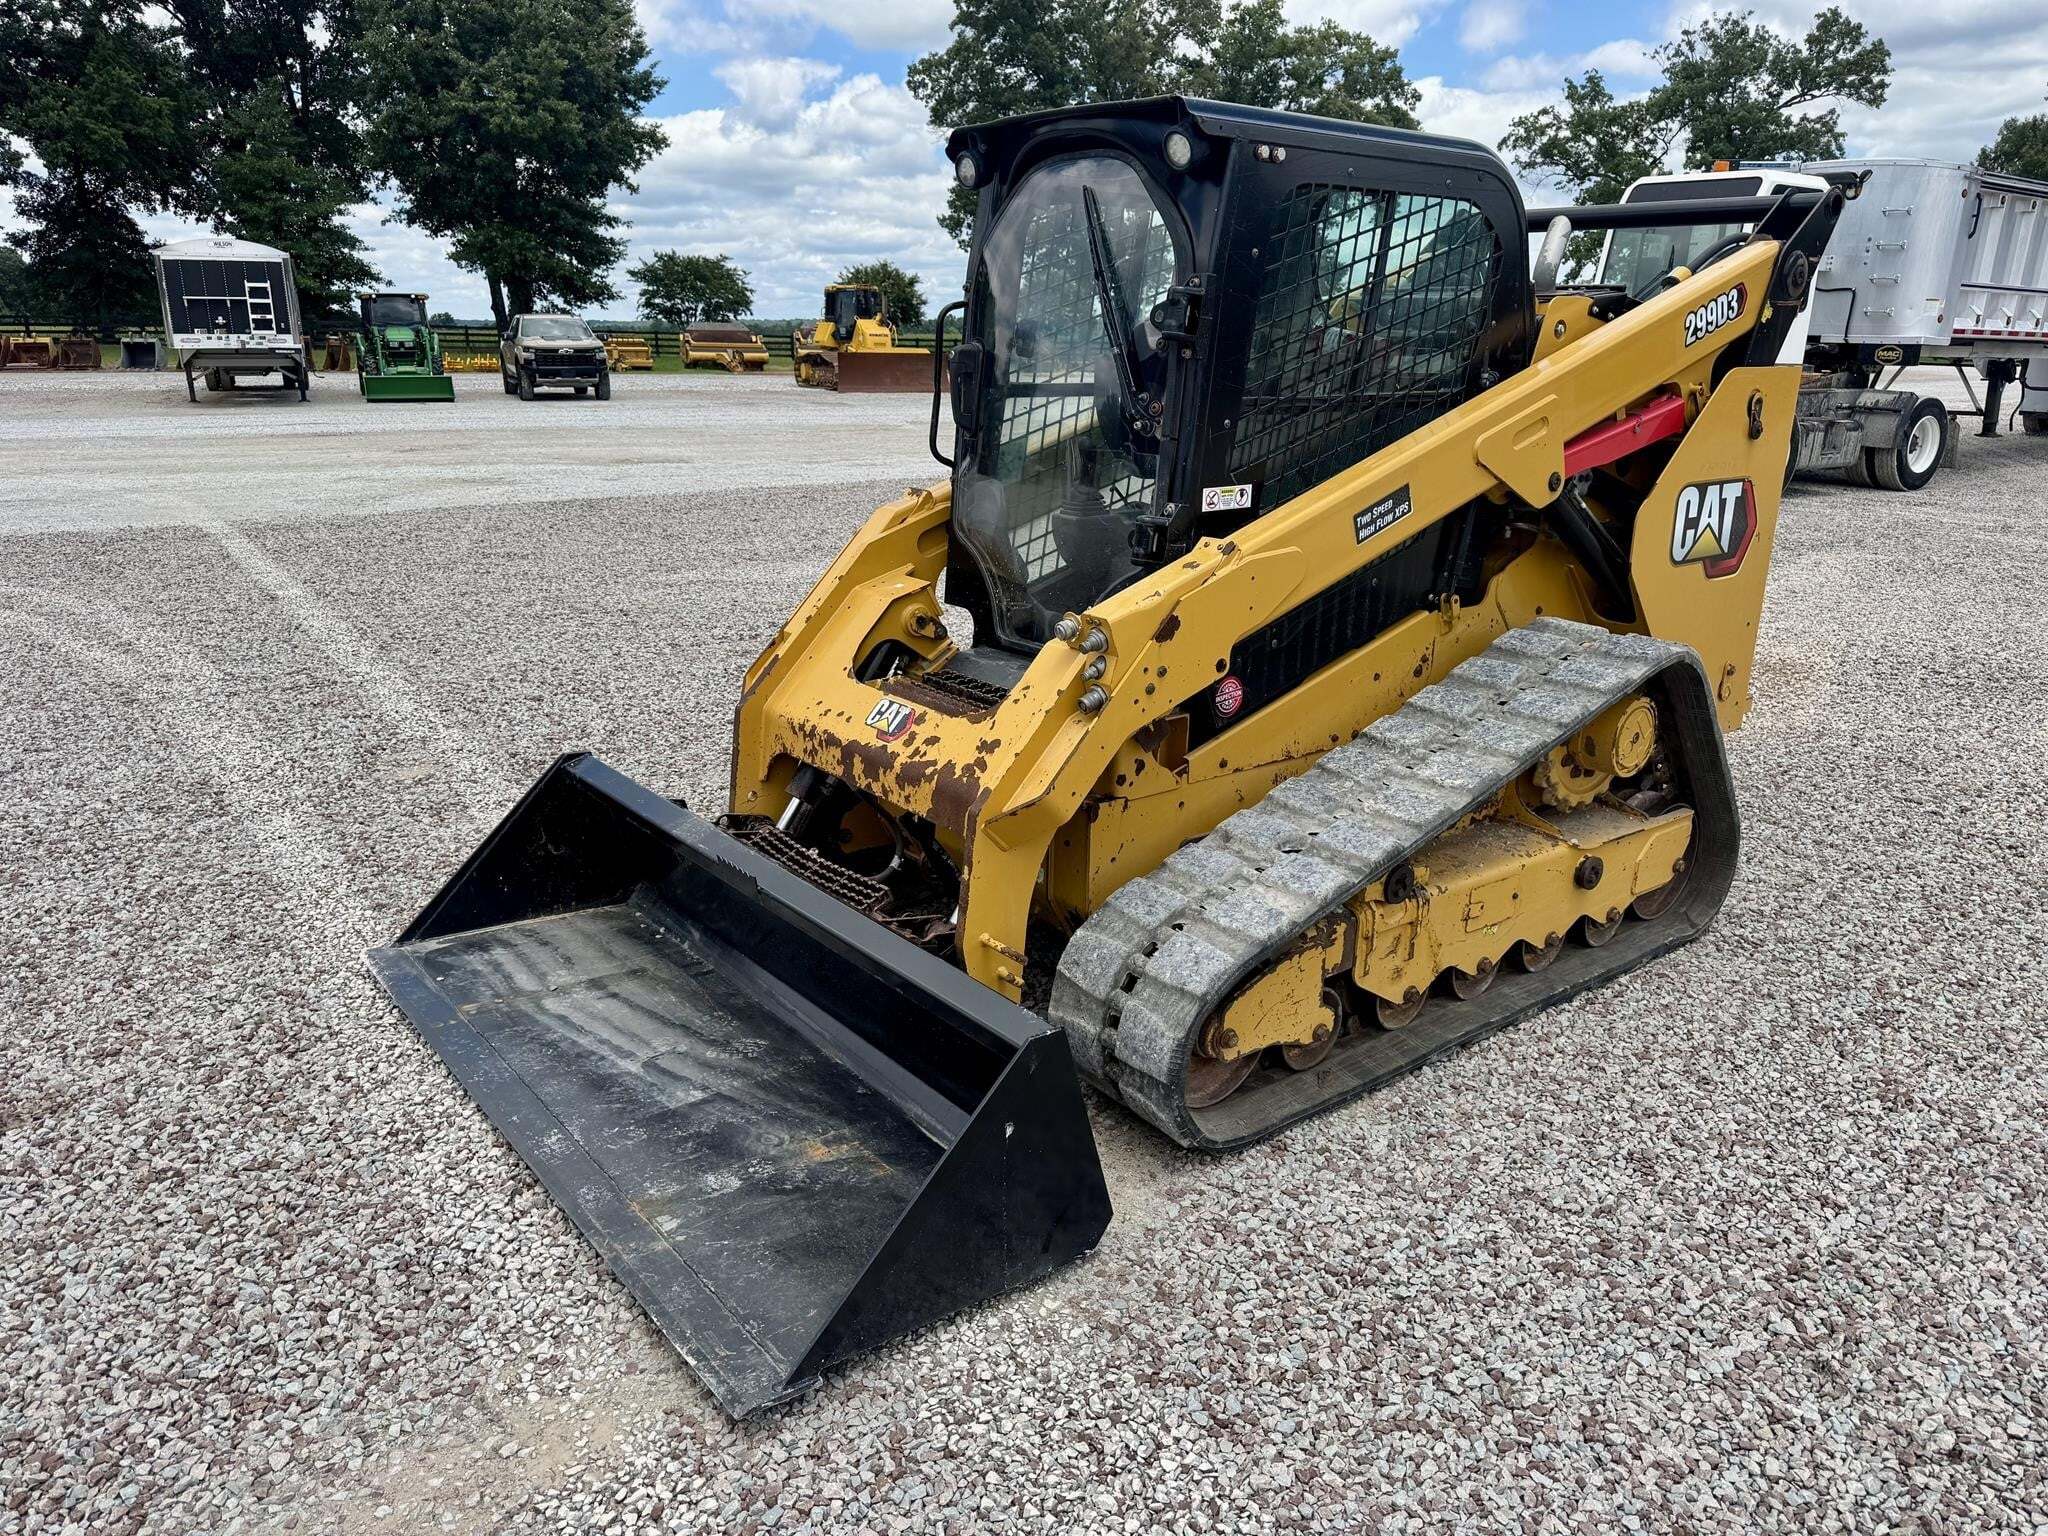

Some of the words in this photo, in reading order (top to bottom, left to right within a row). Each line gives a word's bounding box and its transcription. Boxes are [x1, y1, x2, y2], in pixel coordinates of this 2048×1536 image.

[1685, 287, 1738, 347] 299D3
[1395, 501, 1409, 518] XPS
[1672, 482, 1744, 562] CAT
[866, 699, 912, 734] CAT
